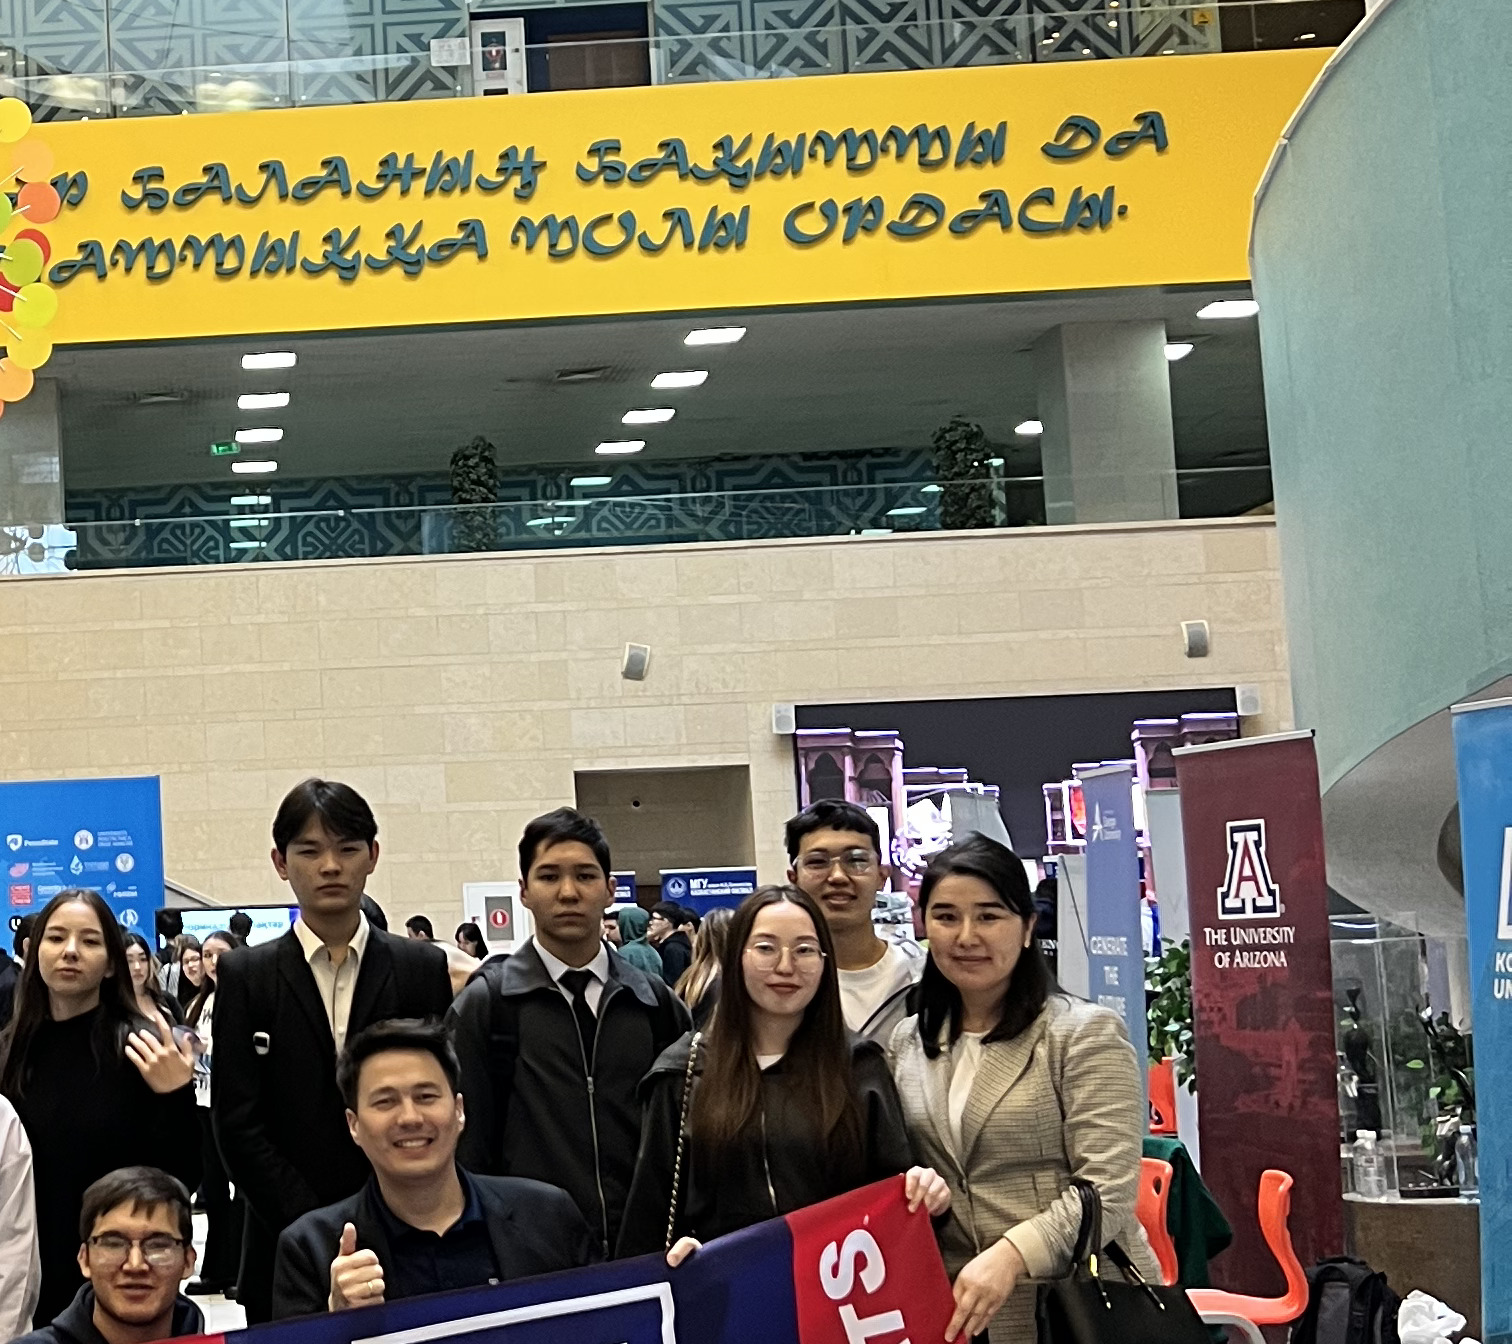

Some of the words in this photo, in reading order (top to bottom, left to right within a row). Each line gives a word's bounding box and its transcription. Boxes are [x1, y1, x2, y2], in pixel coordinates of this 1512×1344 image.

[121, 144, 547, 211] БАЛАНЫҢ
[576, 120, 1007, 189] БАҚЫТТЫ
[1040, 110, 1168, 160] ДА
[510, 203, 752, 256] ТОЛЫ
[1203, 927, 1228, 946] THE
[1230, 926, 1296, 946] UNIVERSITY
[1214, 951, 1231, 969] OF
[1233, 949, 1288, 968] ARIZONA
